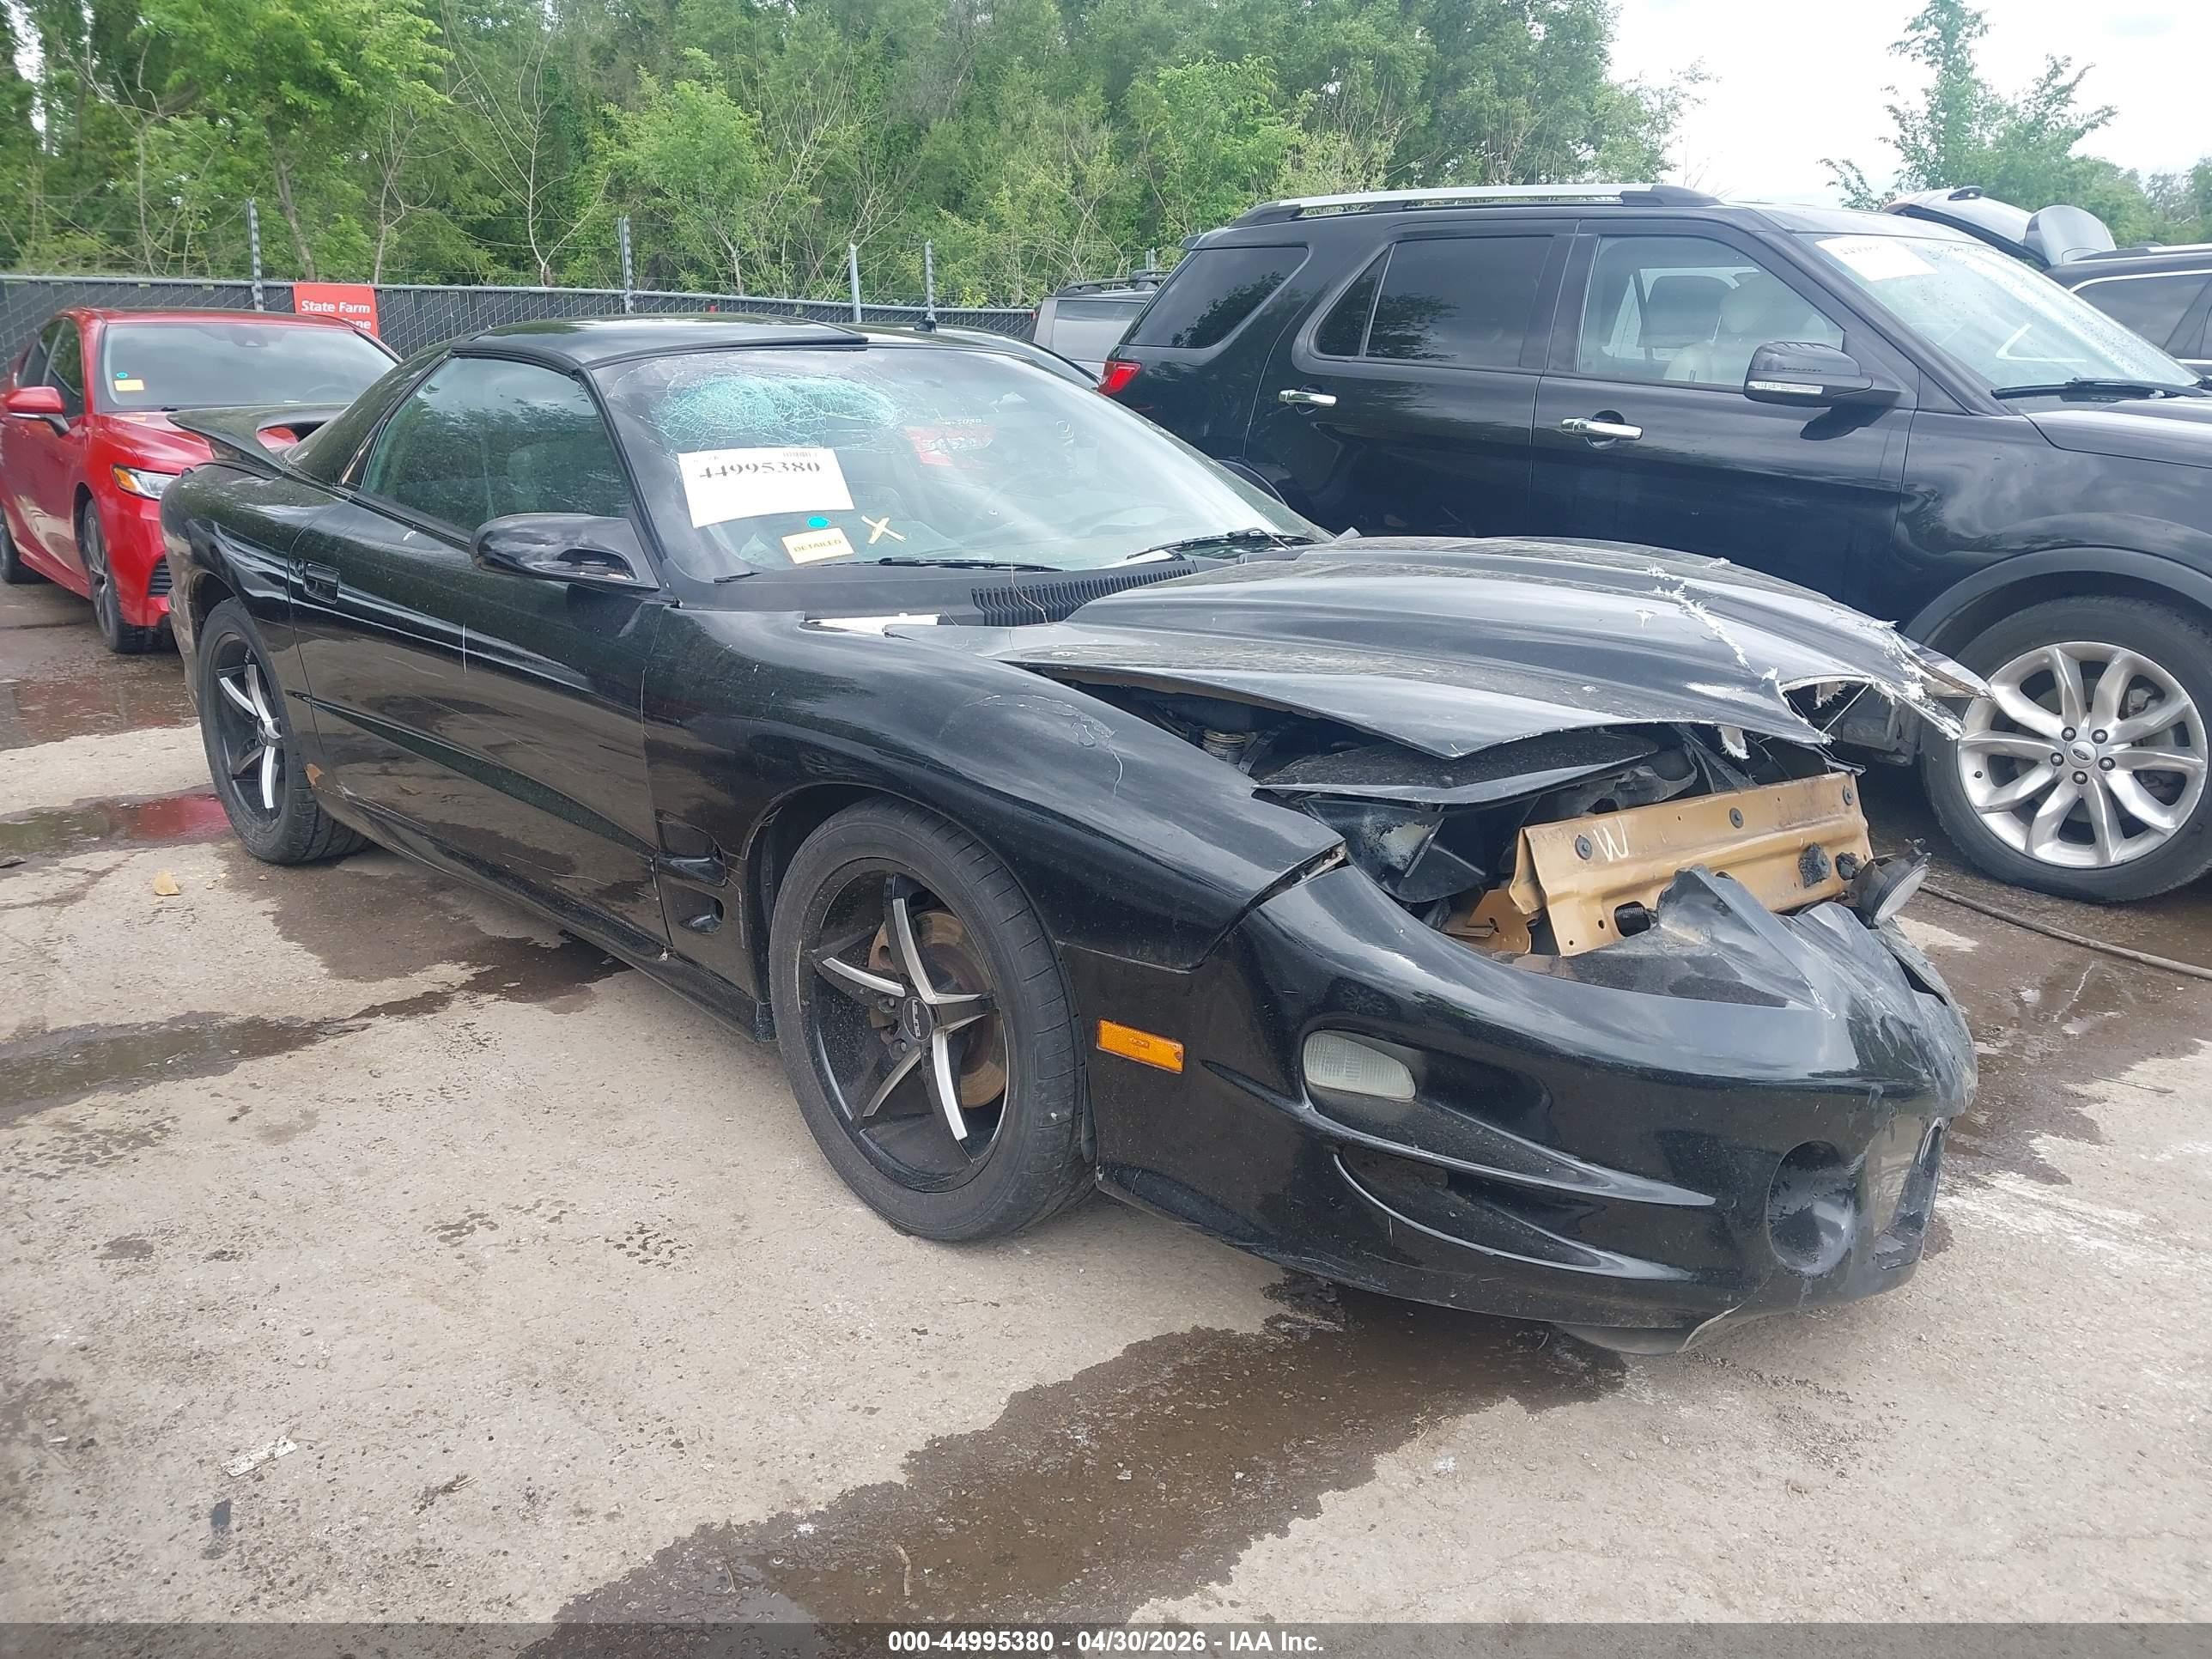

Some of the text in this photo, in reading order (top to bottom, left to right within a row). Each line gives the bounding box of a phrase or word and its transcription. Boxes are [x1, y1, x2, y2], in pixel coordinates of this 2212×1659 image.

[301, 300, 371, 313] State Farm
[700, 461, 821, 478] 44995380
